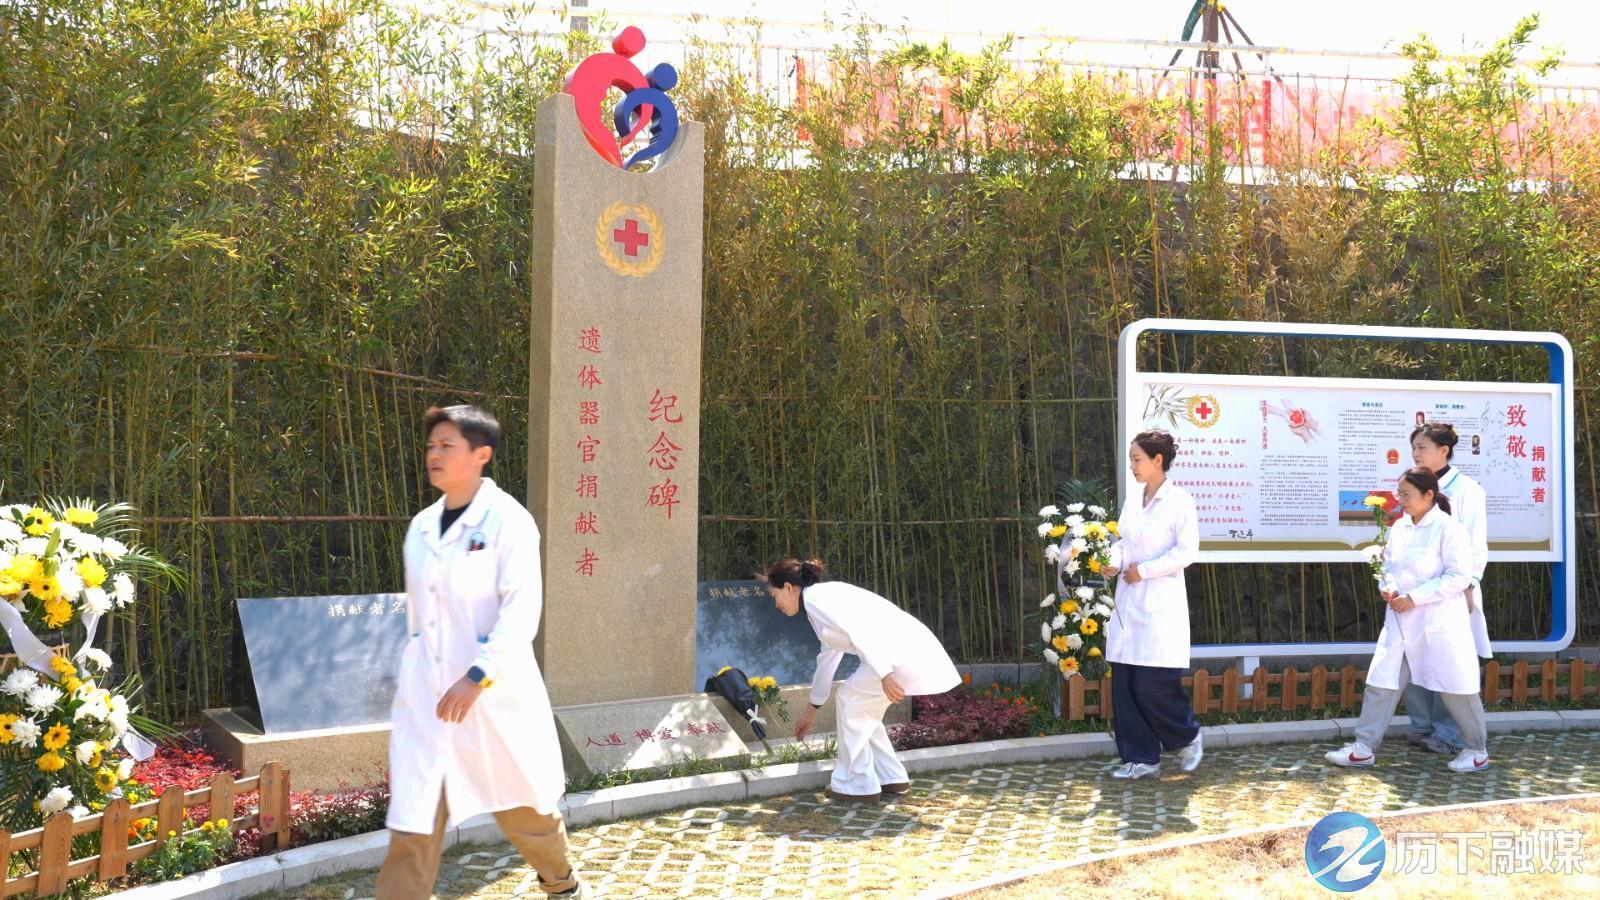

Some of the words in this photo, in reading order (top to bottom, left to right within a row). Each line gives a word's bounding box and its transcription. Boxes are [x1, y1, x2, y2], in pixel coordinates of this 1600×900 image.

[574, 326, 602, 577] 遗体器官捐献者
[645, 388, 683, 520] 纪念碑
[1506, 404, 1527, 458] 致敬
[1531, 445, 1546, 503] 捐献者
[585, 731, 627, 748] 人道
[635, 727, 678, 742] 博爱
[687, 721, 727, 737] 奉献
